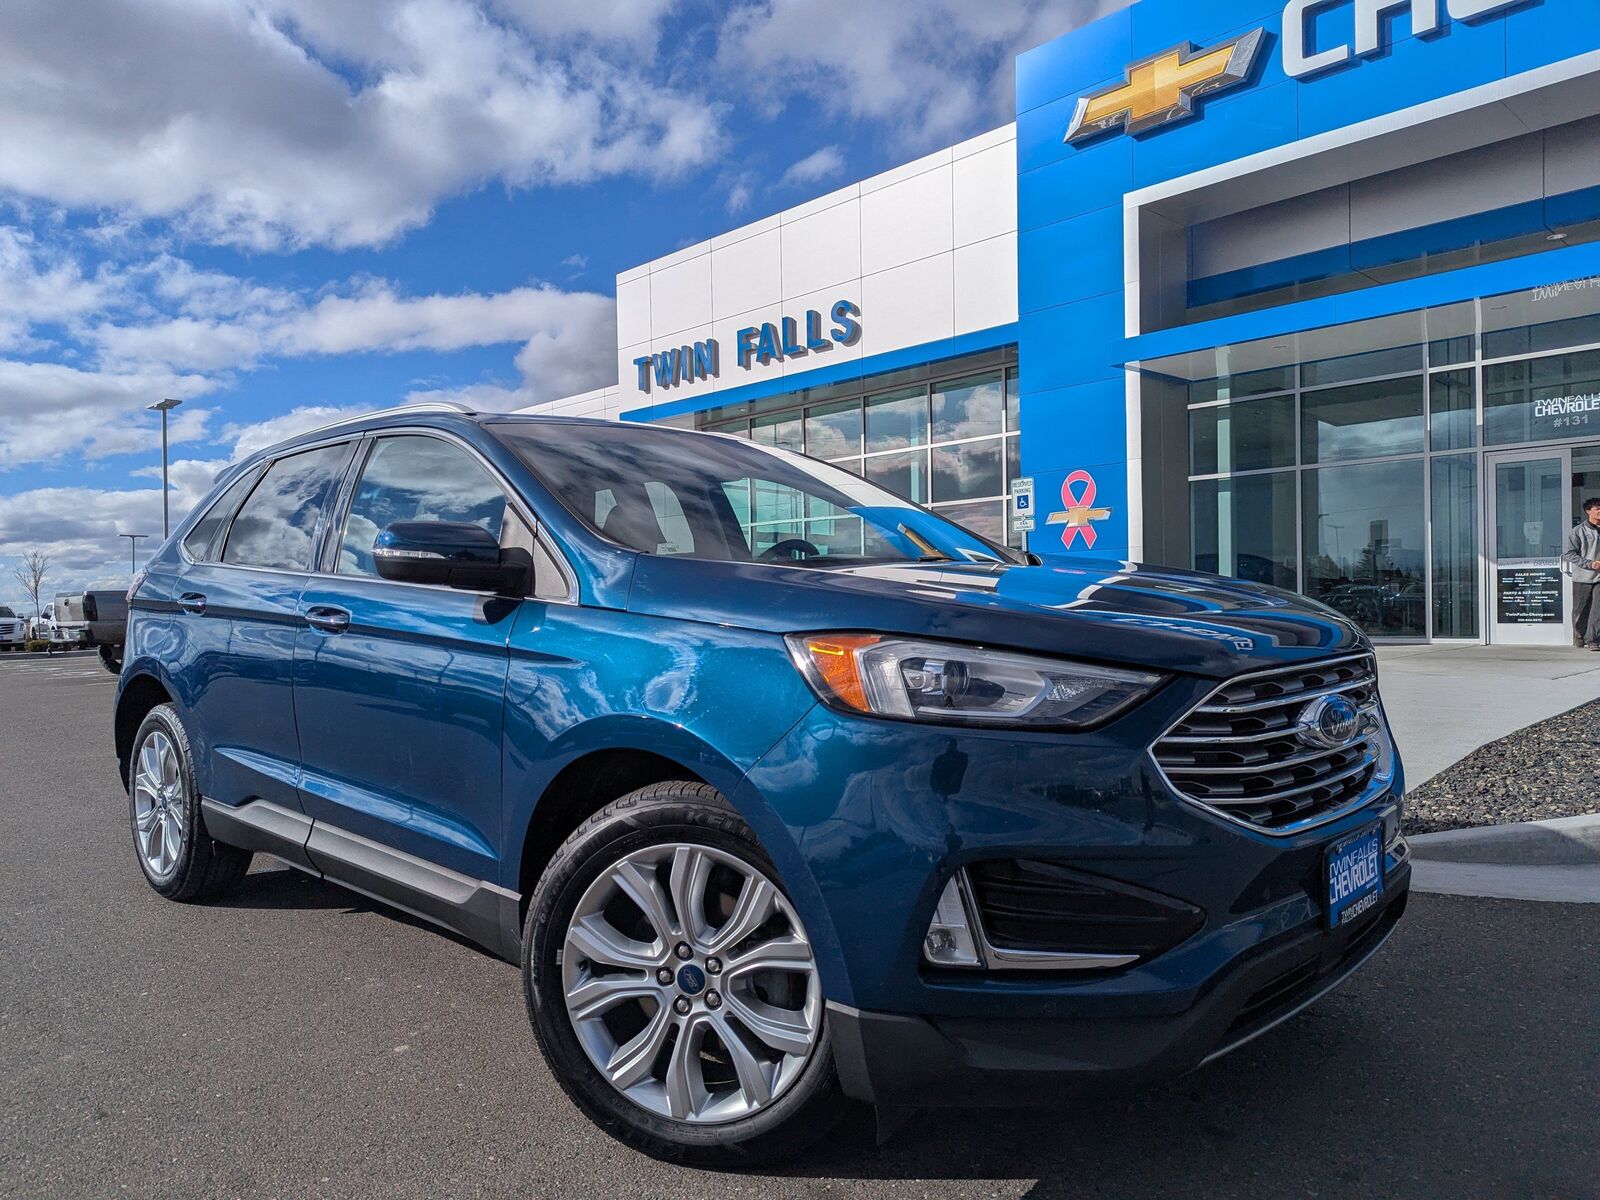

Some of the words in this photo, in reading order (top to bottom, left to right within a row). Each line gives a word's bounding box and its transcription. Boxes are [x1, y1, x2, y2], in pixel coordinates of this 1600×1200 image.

[1282, 0, 1508, 76] CH
[633, 338, 720, 394] TWIN
[736, 299, 863, 371] FALLS
[1553, 414, 1589, 428] #131
[1329, 838, 1379, 880] TWINFALLS
[1329, 852, 1379, 905] CHEVROLET
